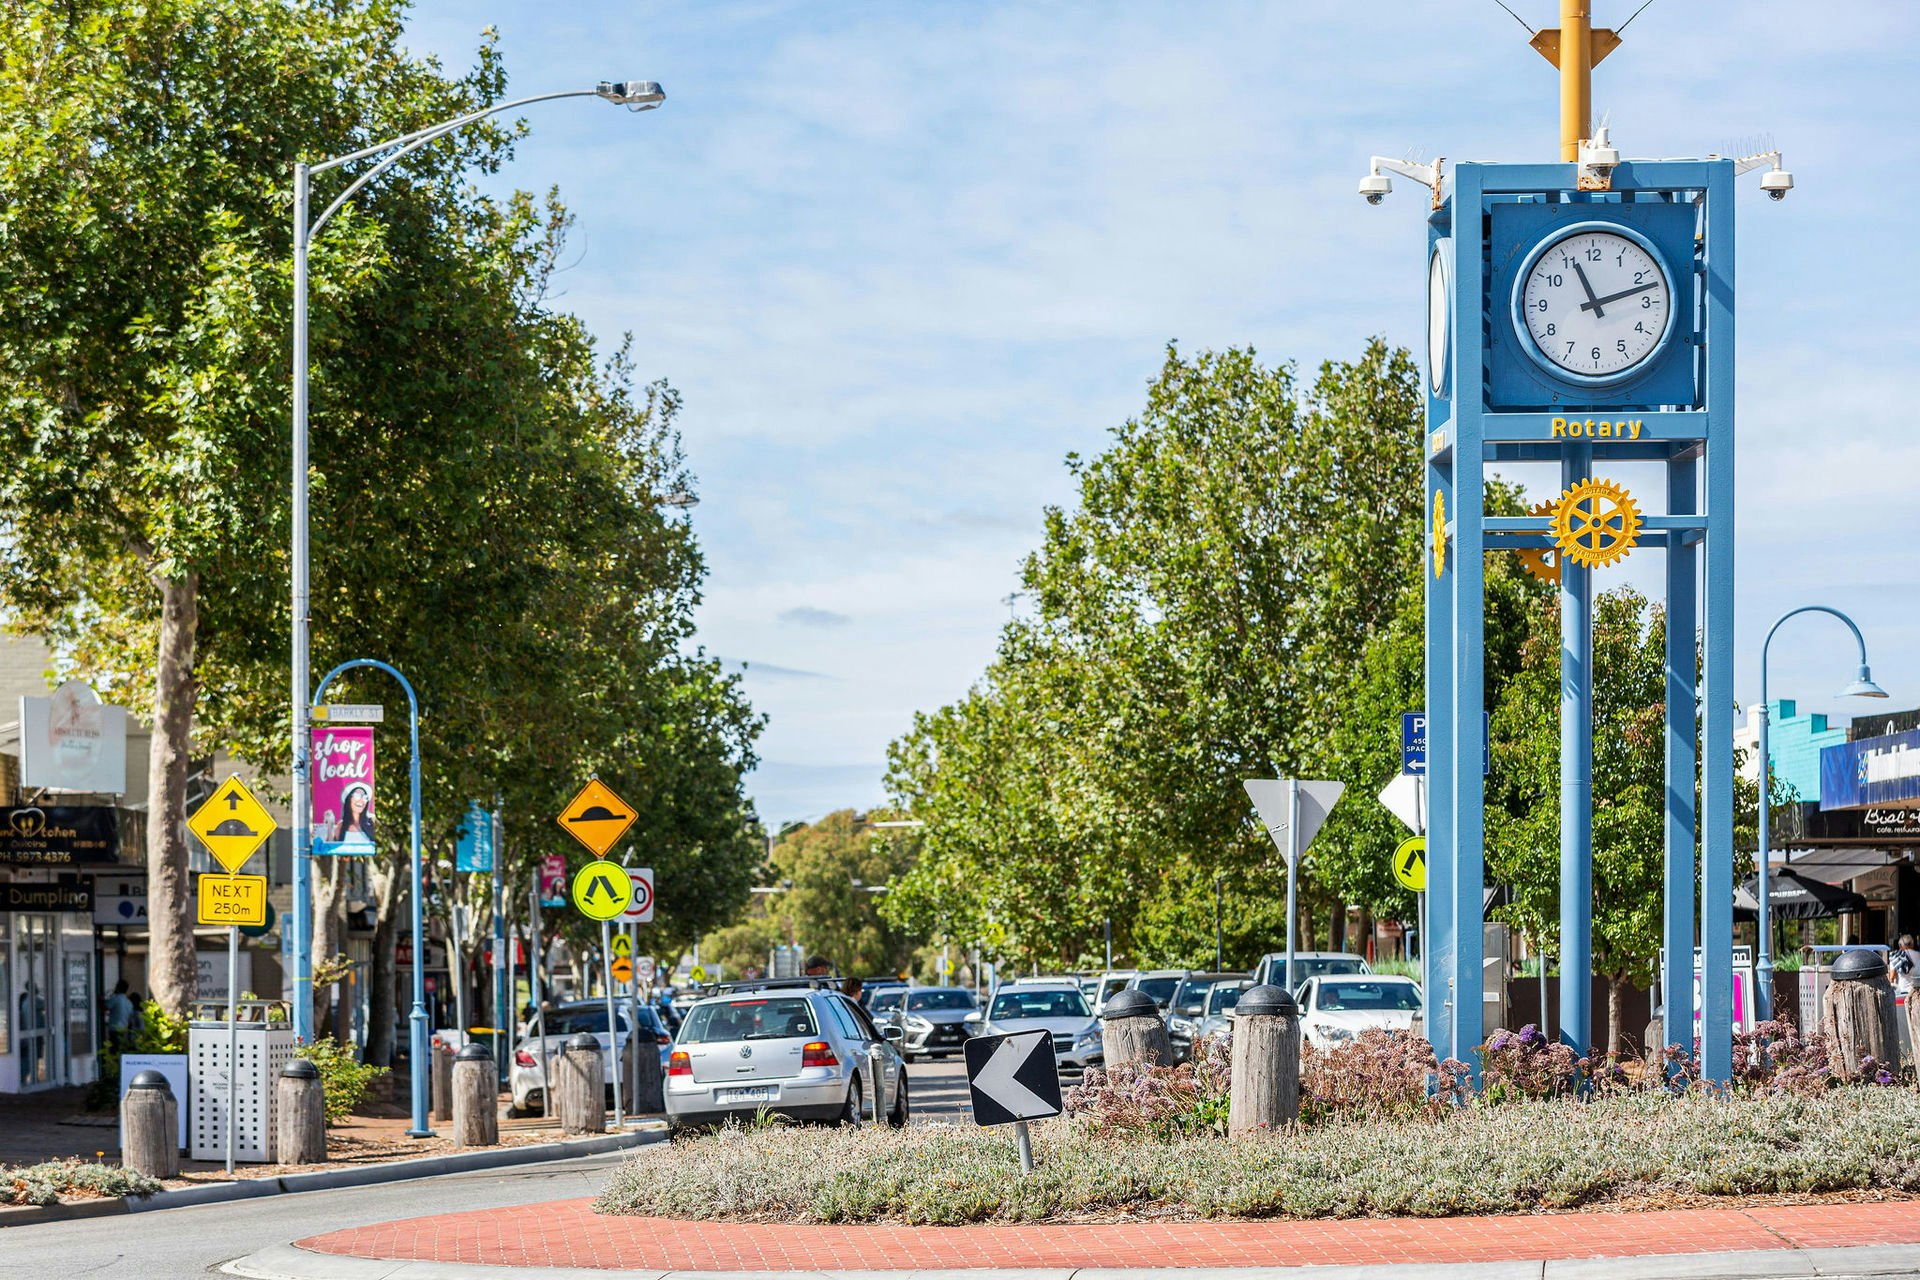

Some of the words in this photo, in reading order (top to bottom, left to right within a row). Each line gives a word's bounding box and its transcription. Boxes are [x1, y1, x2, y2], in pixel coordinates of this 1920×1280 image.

[1585, 249, 1602, 261] 12
[1616, 255, 1622, 267] 1
[1562, 256, 1577, 269] 11
[1546, 275, 1562, 287] 10
[1634, 272, 1643, 284] 2
[1538, 300, 1548, 312] 9
[1641, 296, 1651, 309] 3
[1546, 323, 1556, 336] 8
[1634, 321, 1644, 333] 4
[1566, 341, 1575, 353] 7
[1617, 340, 1626, 352] 5
[1591, 347, 1600, 360] 6
[1552, 417, 1642, 440] Rotary
[1583, 487, 1610, 495] ROTARY
[314, 733, 365, 760] shop
[320, 753, 369, 782] local
[9, 887, 89, 908] Dumpling
[212, 885, 252, 898] NEXT
[634, 887, 647, 904] 0
[213, 902, 251, 915] 250m
